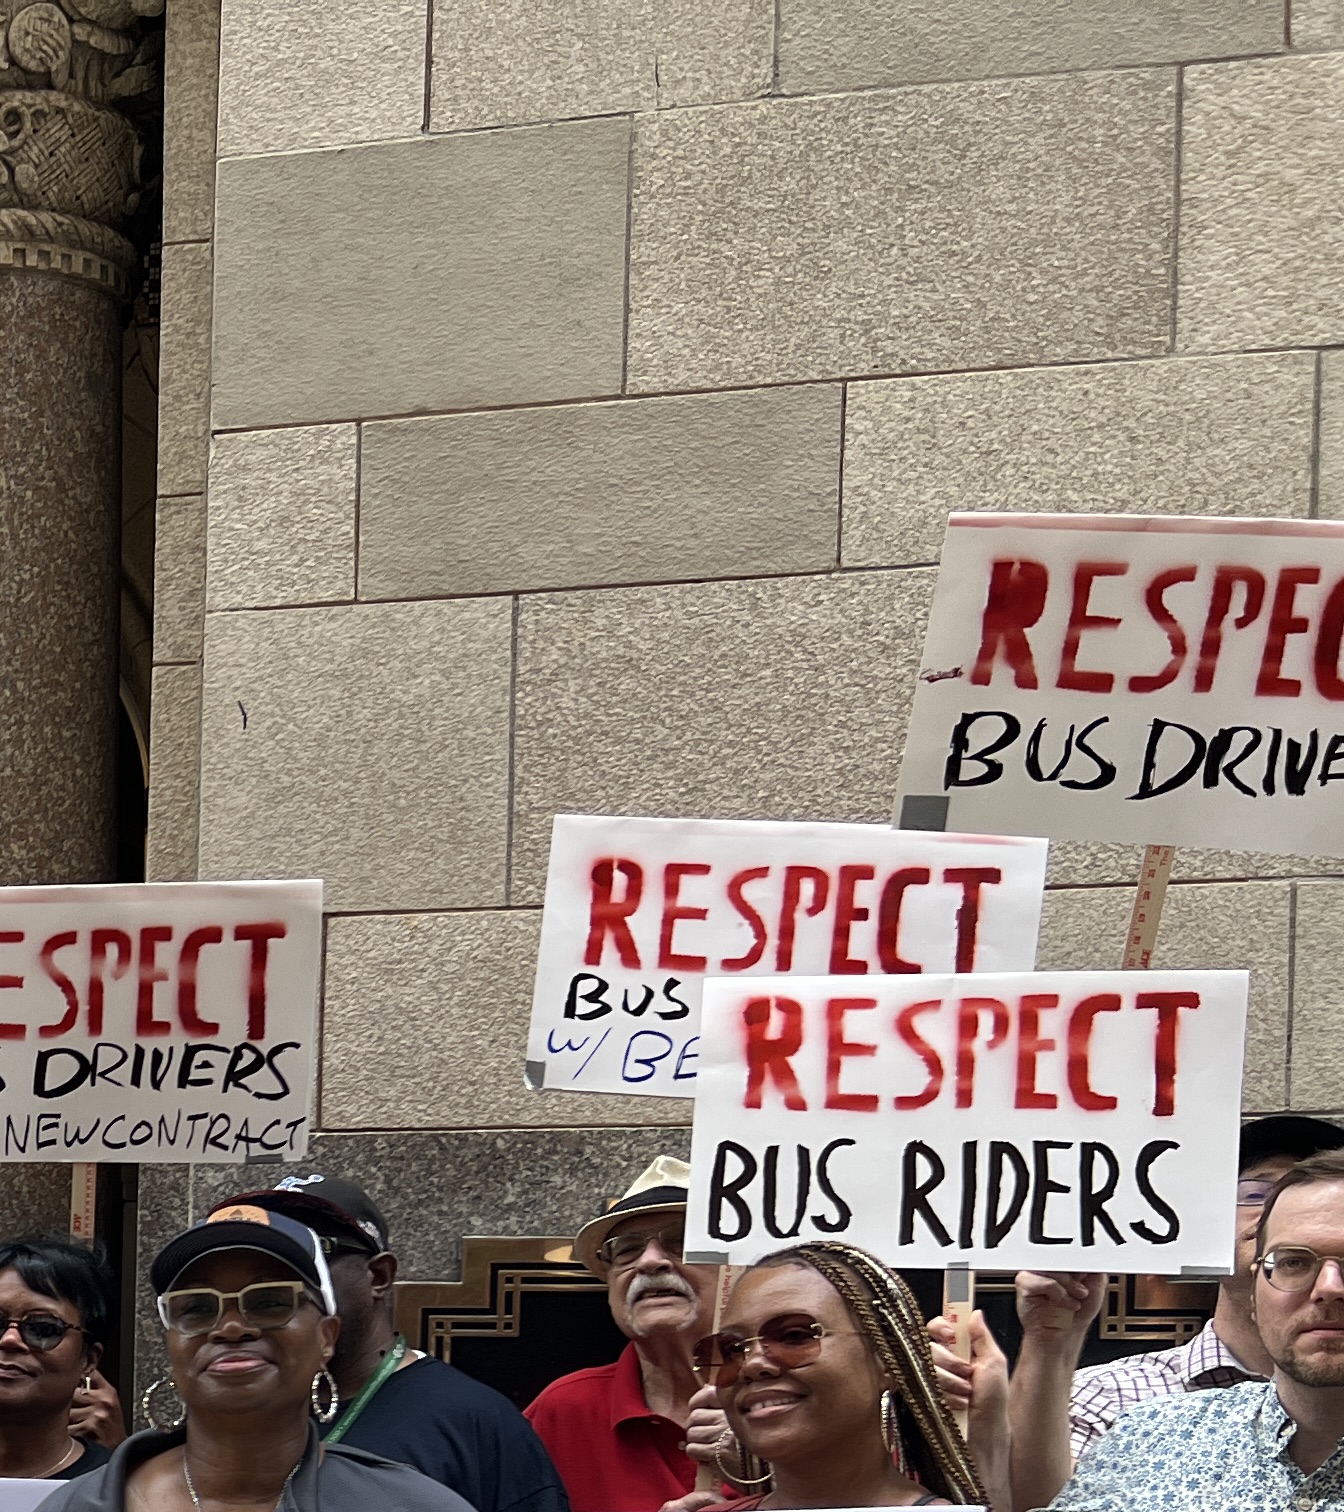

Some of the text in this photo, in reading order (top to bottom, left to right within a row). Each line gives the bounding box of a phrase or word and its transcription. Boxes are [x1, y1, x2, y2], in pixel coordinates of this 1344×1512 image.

[945, 711, 1117, 791] BUS
[582, 855, 1002, 975] RESPECT
[563, 972, 690, 1021] BUS
[33, 1041, 301, 1100] DRIVERS
[742, 992, 1201, 1118] RESPECT
[710, 1138, 1181, 1250] BUS RIDERS
